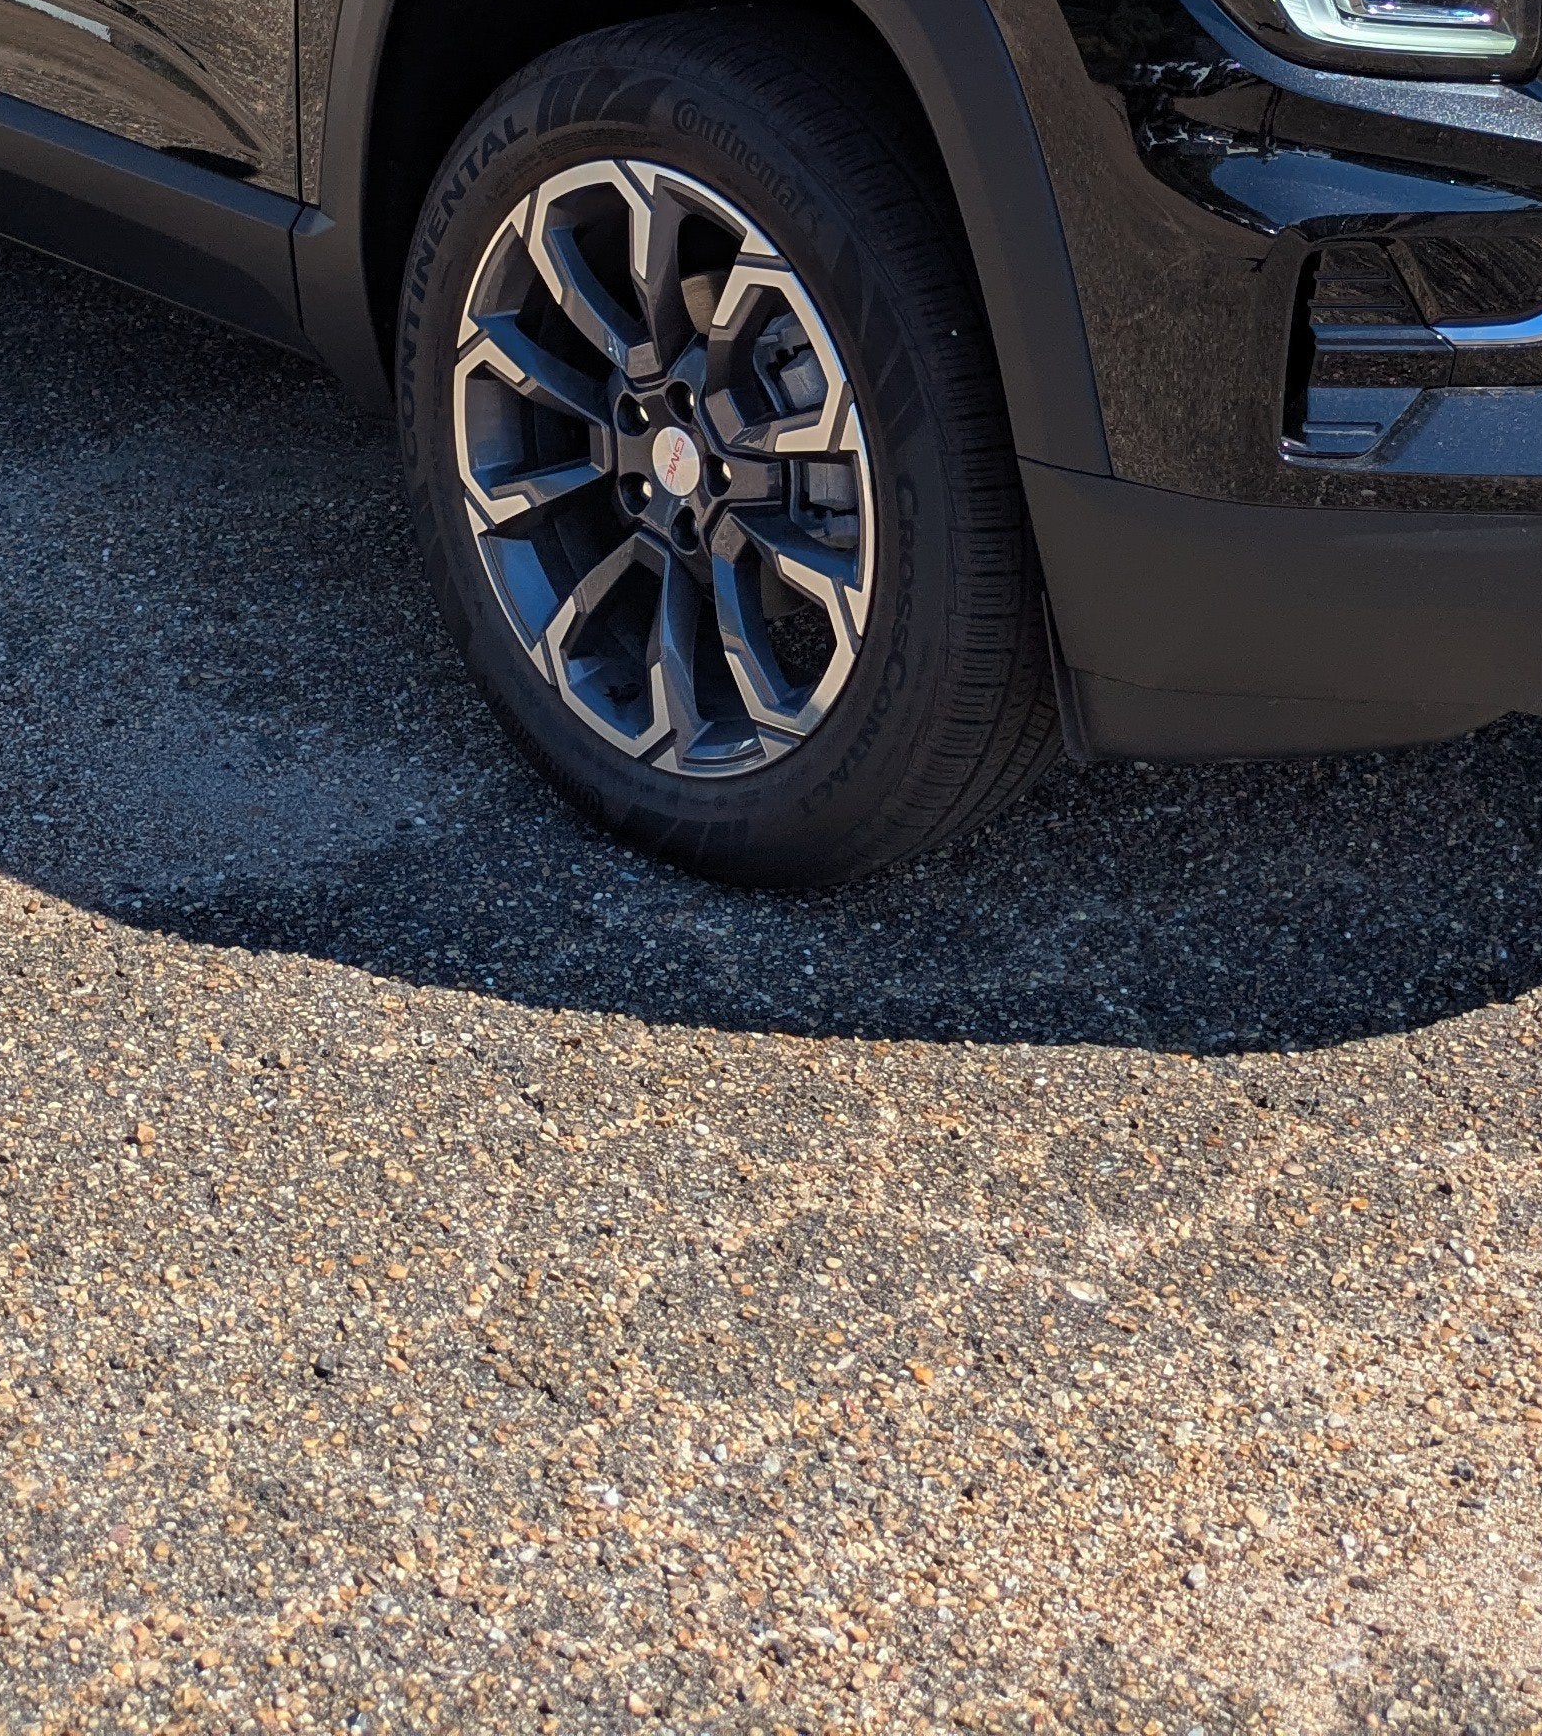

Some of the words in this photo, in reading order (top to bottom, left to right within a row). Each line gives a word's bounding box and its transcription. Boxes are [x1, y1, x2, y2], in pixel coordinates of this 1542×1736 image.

[672, 97, 810, 221] Continental
[399, 113, 531, 470] CONTINENTAL
[664, 436, 685, 488] GMC
